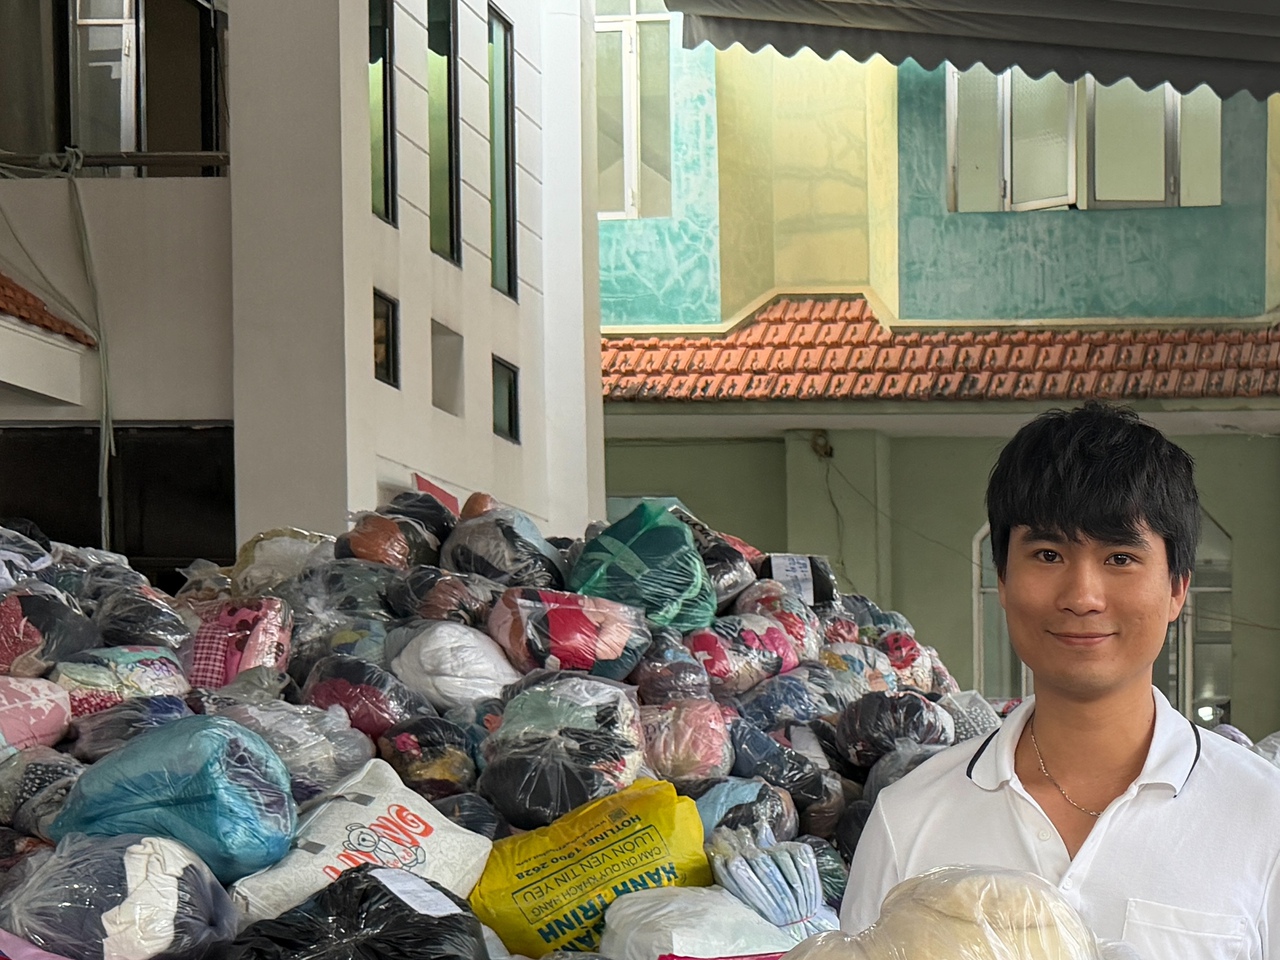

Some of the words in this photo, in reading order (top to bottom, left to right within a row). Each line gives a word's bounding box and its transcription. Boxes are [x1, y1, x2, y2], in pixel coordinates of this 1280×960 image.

[582, 814, 642, 848] HOTLINE:
[550, 846, 582, 864] 1900
[611, 832, 655, 858] LUÔN
[515, 861, 550, 880] 2628
[553, 868, 582, 888] TIN
